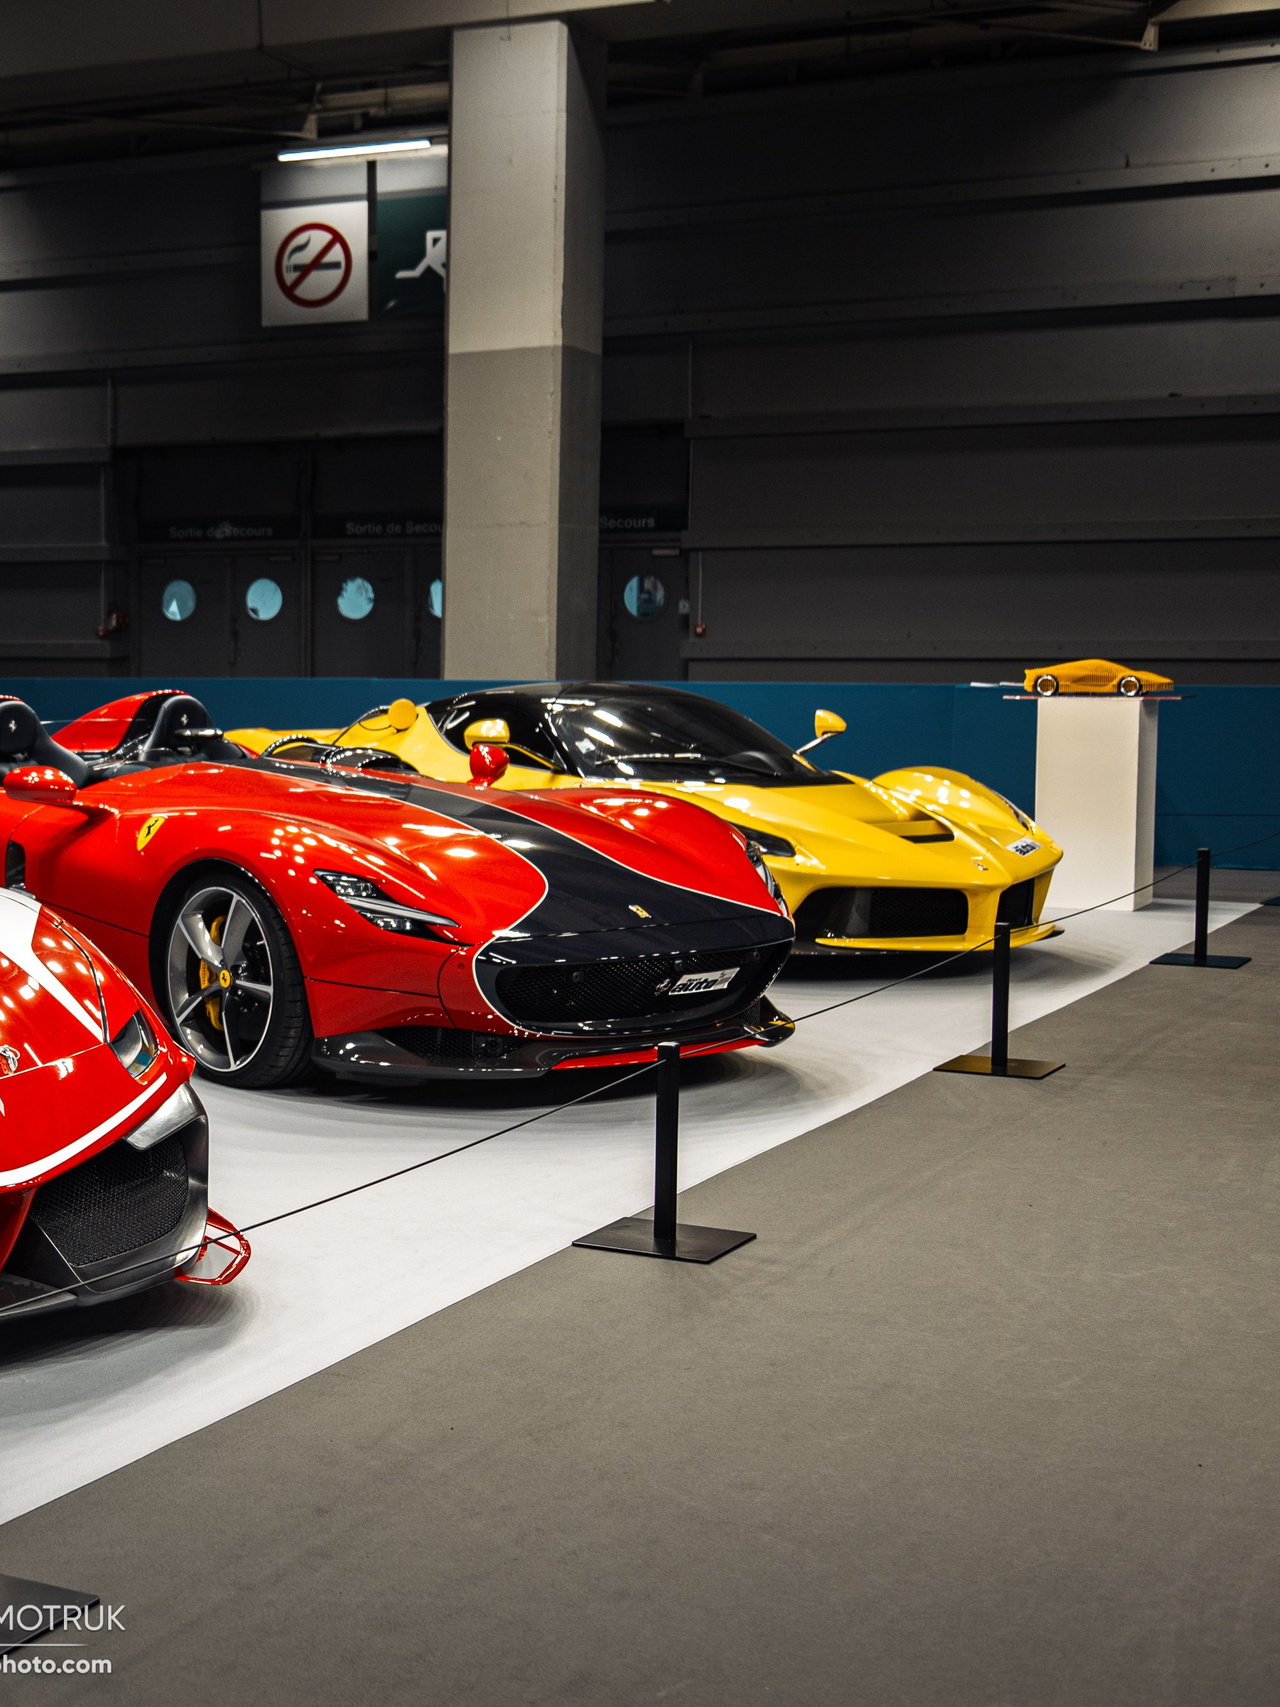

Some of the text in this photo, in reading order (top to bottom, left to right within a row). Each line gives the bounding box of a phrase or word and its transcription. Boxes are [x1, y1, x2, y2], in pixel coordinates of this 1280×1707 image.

[345, 521, 383, 535] Sortie
[385, 522, 403, 534] de
[599, 516, 655, 529] Secours
[169, 526, 204, 539] Sortie
